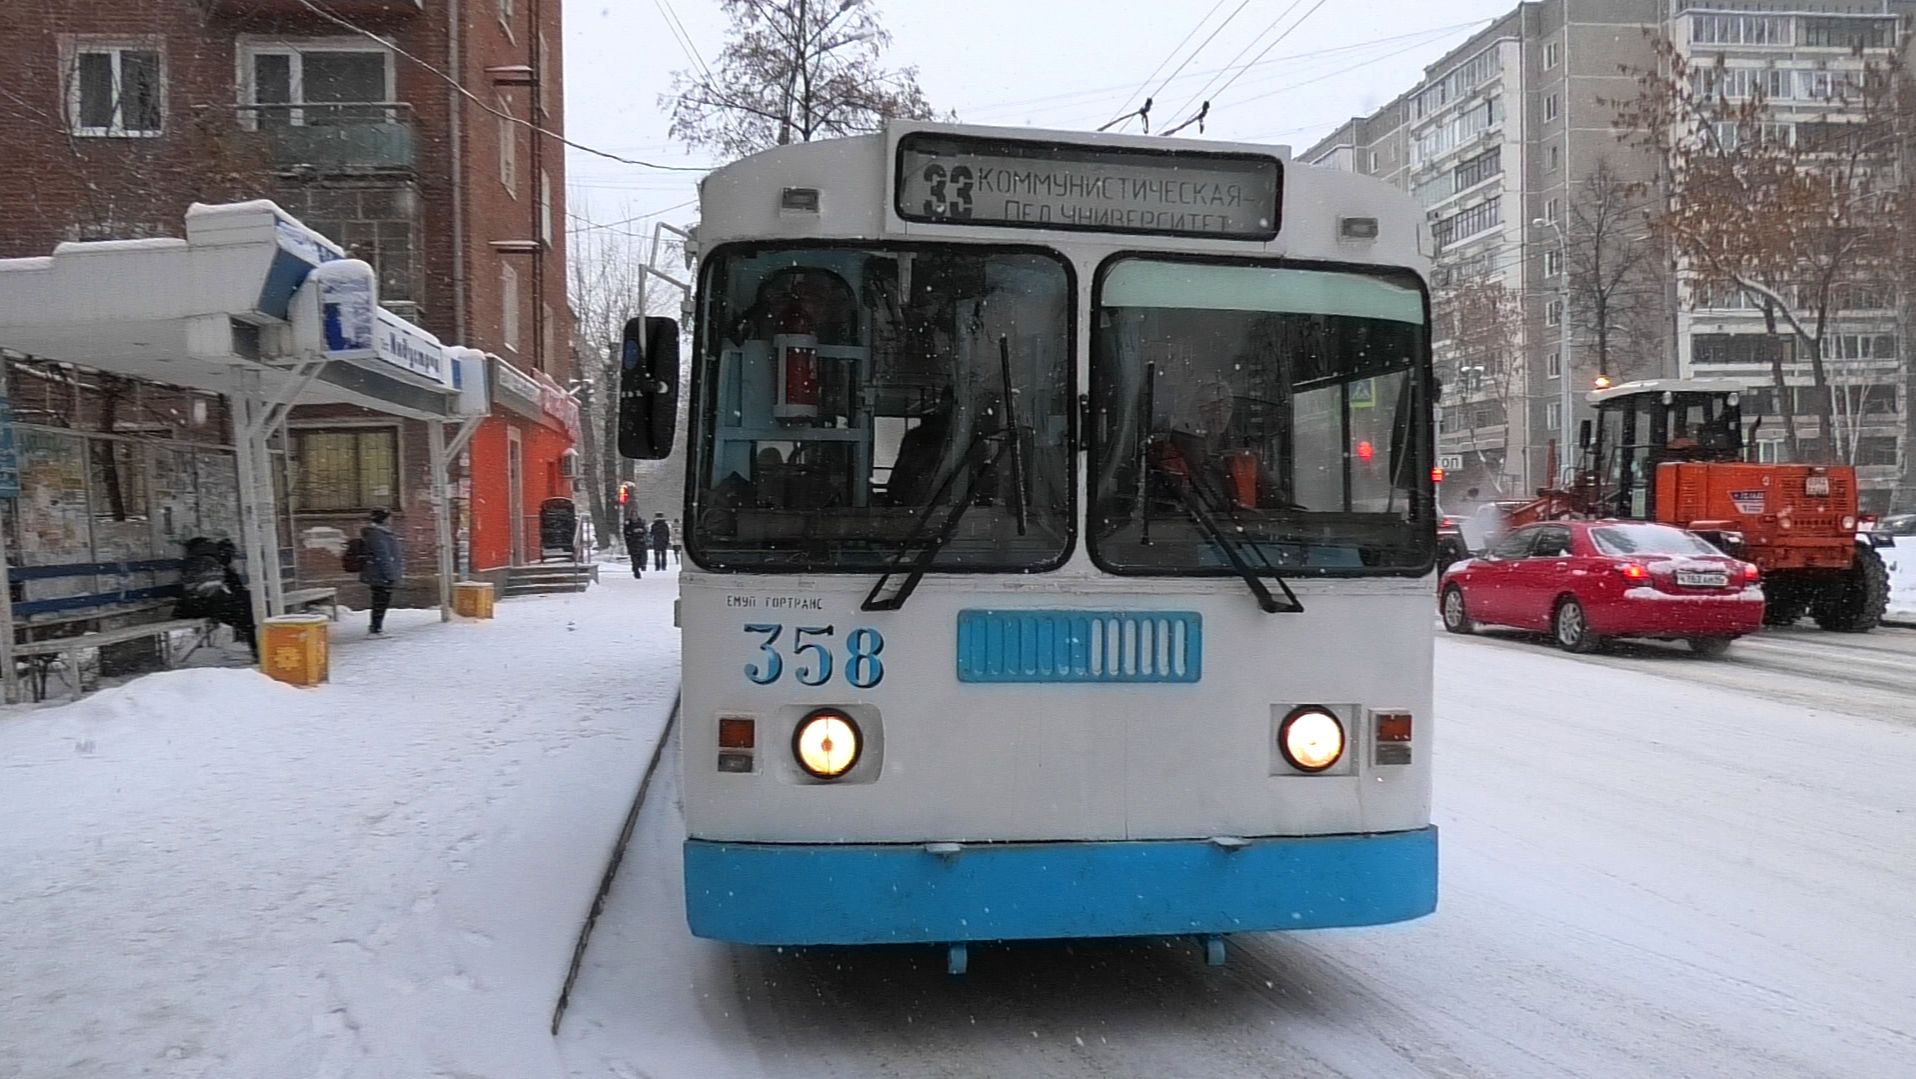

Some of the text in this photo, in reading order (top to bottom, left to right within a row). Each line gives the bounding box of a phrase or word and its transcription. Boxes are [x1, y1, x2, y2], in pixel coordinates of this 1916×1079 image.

[923, 163, 974, 219] 33
[1060, 204, 1229, 232] УНИВЕРСИТЕТ
[727, 595, 823, 610] ЕМУП ГОРТРАНС
[743, 623, 884, 689] 358
